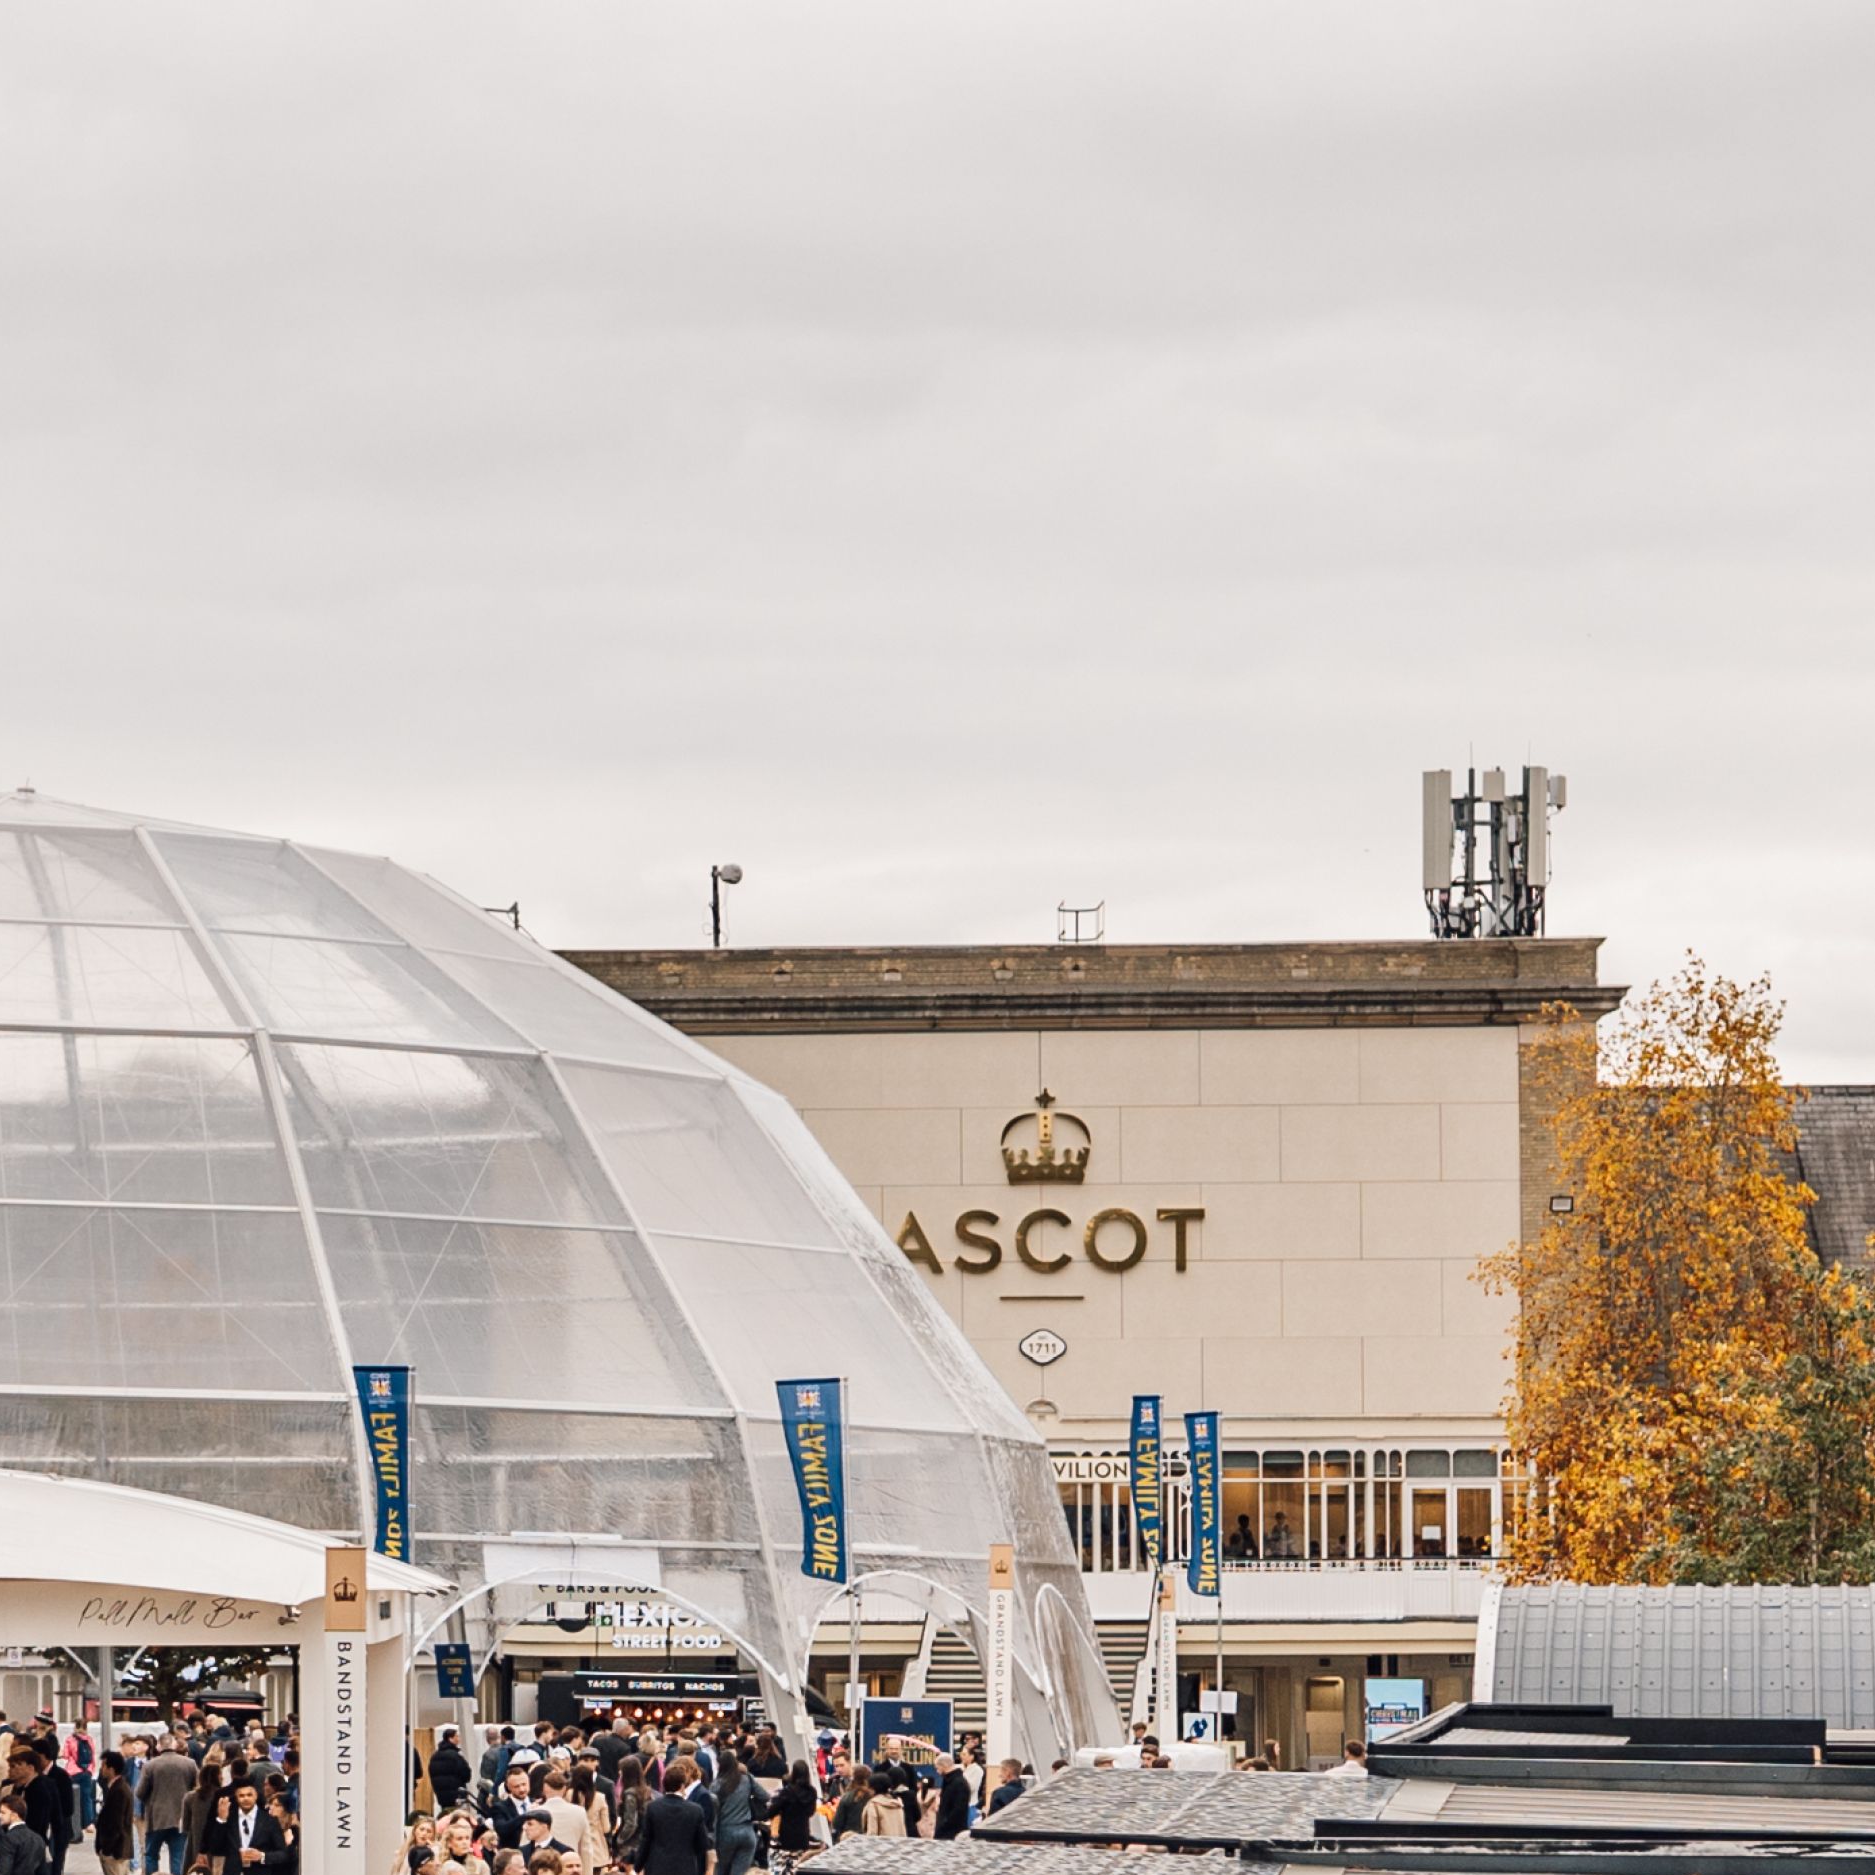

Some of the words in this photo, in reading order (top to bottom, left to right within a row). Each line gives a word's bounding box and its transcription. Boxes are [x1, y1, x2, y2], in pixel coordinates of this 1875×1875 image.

[894, 1207, 1206, 1275] ASCOT
[1028, 1342, 1057, 1354] 1711
[612, 1634, 668, 1649] STREET
[672, 1634, 722, 1649] FOOD
[995, 1593, 1006, 1677] GRANDSTAND
[336, 1641, 352, 1775] BANDSTAND
[586, 1679, 619, 1688] TACOS
[995, 1681, 1005, 1717] LAWN
[336, 1786, 351, 1849] LAWN
